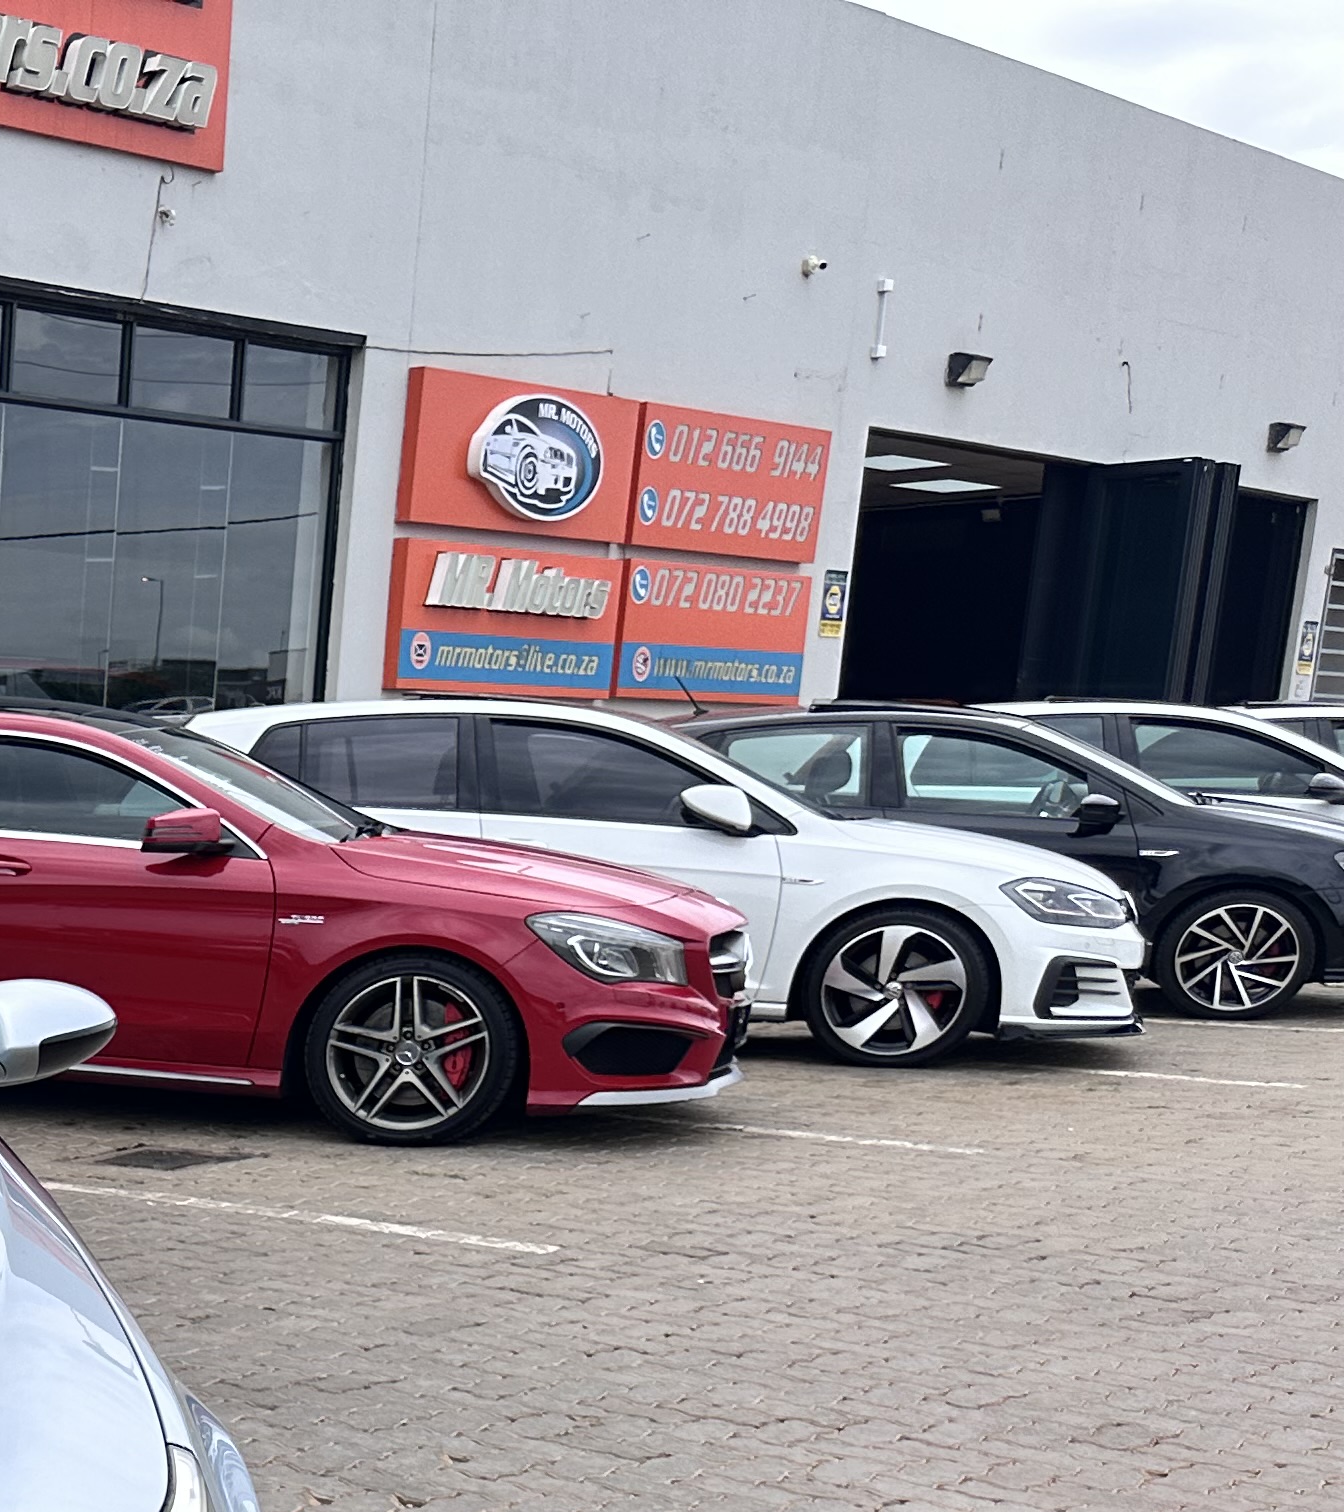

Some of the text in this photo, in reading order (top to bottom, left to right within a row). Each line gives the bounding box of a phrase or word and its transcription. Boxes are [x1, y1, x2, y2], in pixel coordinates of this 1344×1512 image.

[538, 403, 599, 459] MR. MOTORS
[669, 424, 824, 480] 012 666 9144
[662, 488, 814, 542] 072 788 4998
[489, 559, 611, 619] Motors
[650, 569, 699, 609] 072
[698, 573, 745, 612] 080
[743, 577, 802, 616] 2237
[654, 657, 795, 684] www.mrmotors.co.za
